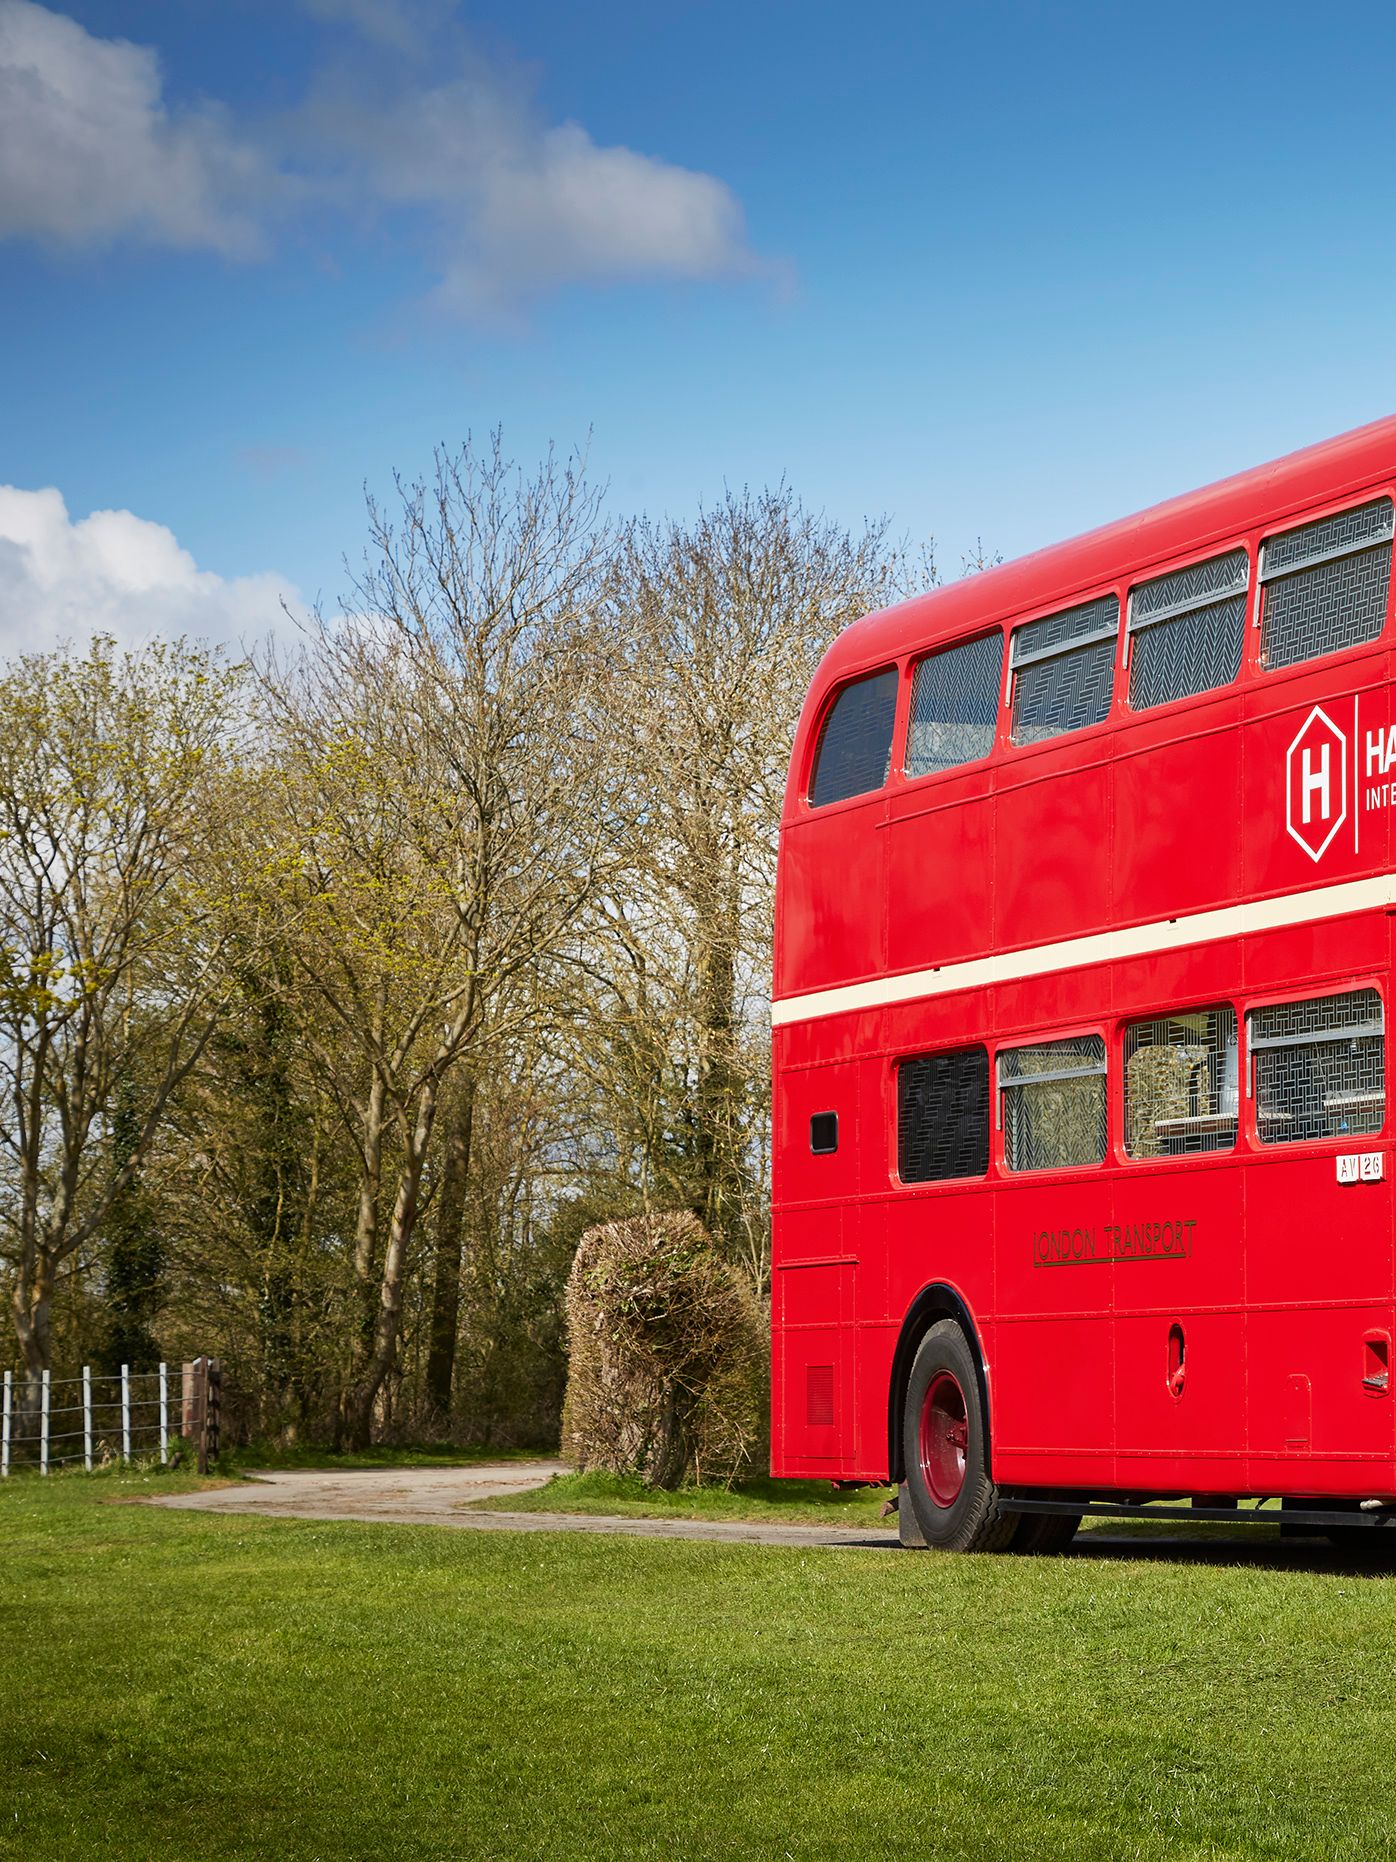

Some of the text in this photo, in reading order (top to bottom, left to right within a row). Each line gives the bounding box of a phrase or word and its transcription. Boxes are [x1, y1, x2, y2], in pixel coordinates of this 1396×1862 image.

[1302, 743, 1330, 824] H
[1341, 1156, 1380, 1177] AV 26
[1033, 1219, 1197, 1267] LONDON TRANSPORT
